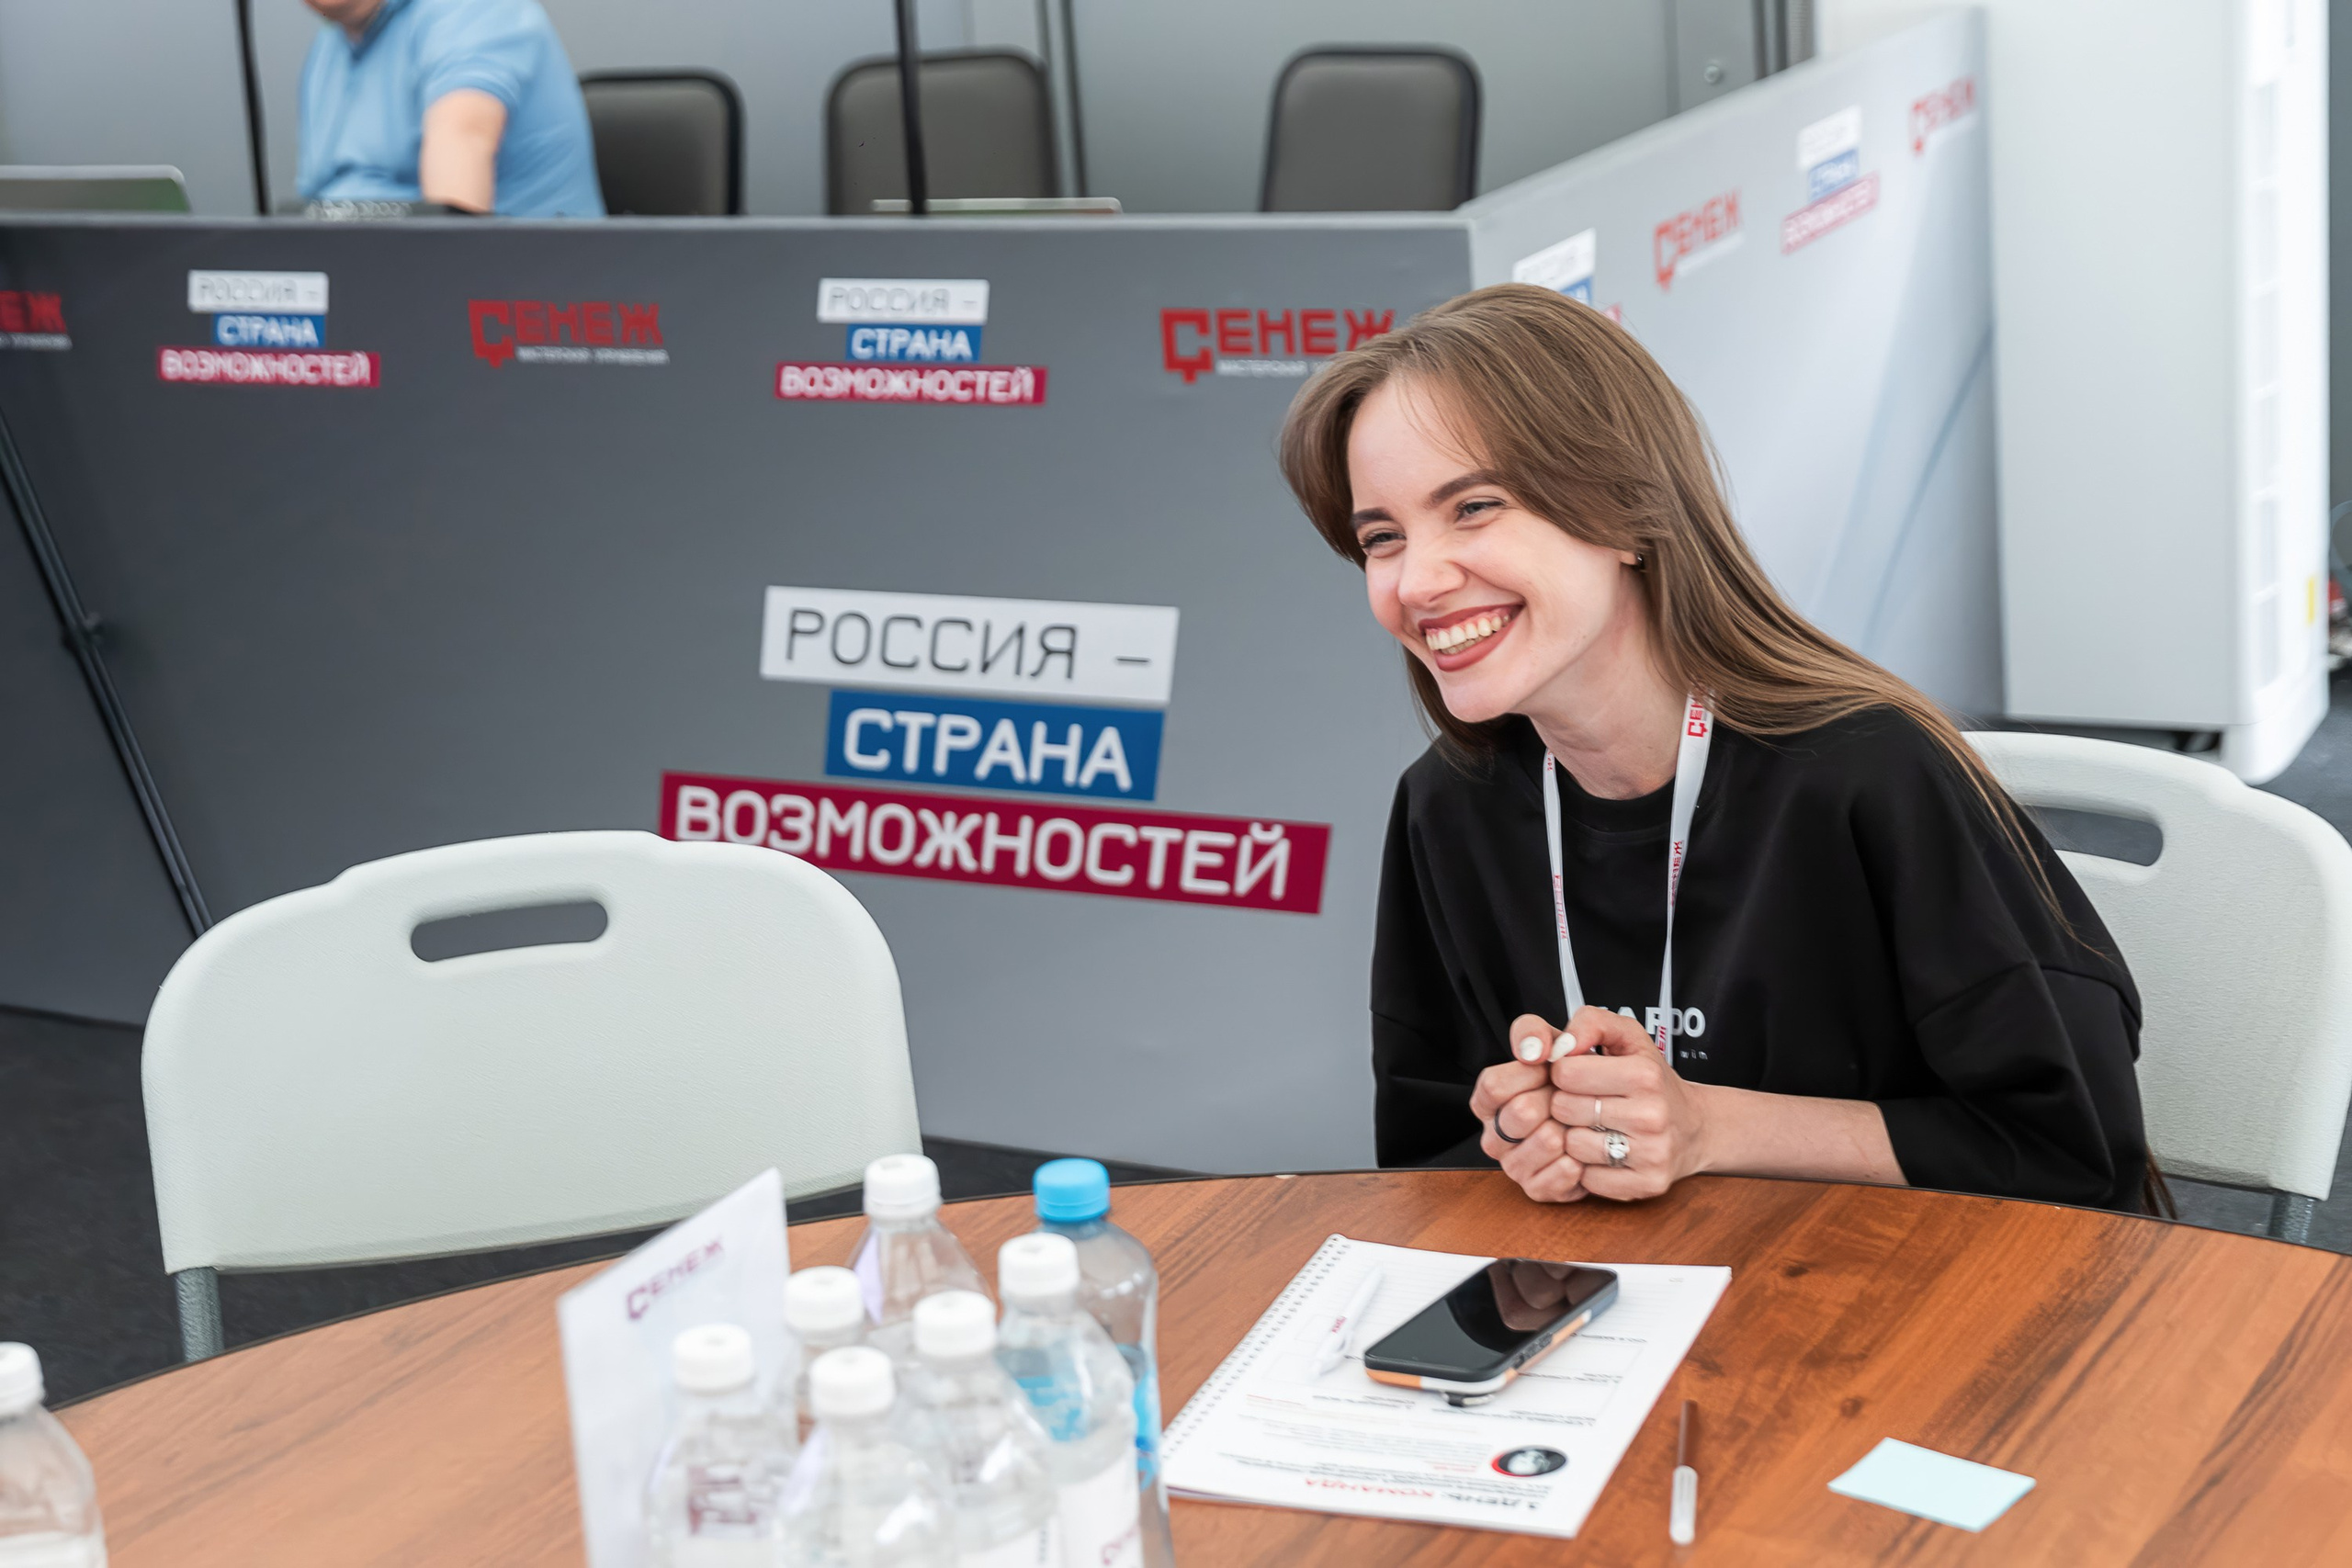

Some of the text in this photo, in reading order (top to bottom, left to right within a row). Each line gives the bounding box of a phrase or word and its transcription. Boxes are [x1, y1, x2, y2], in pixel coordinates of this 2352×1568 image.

[217, 315, 320, 347] СТРАНА
[468, 299, 664, 368] СЕНЕЖ
[851, 327, 973, 361] СТРАНА
[780, 365, 1036, 404] ВОЗМОЖНОСТЕЙ
[785, 606, 1079, 680] РОССИЯ
[842, 706, 1134, 792] СТРАНА
[675, 784, 1292, 900] ВОЗМОЖНОСТЕЙ
